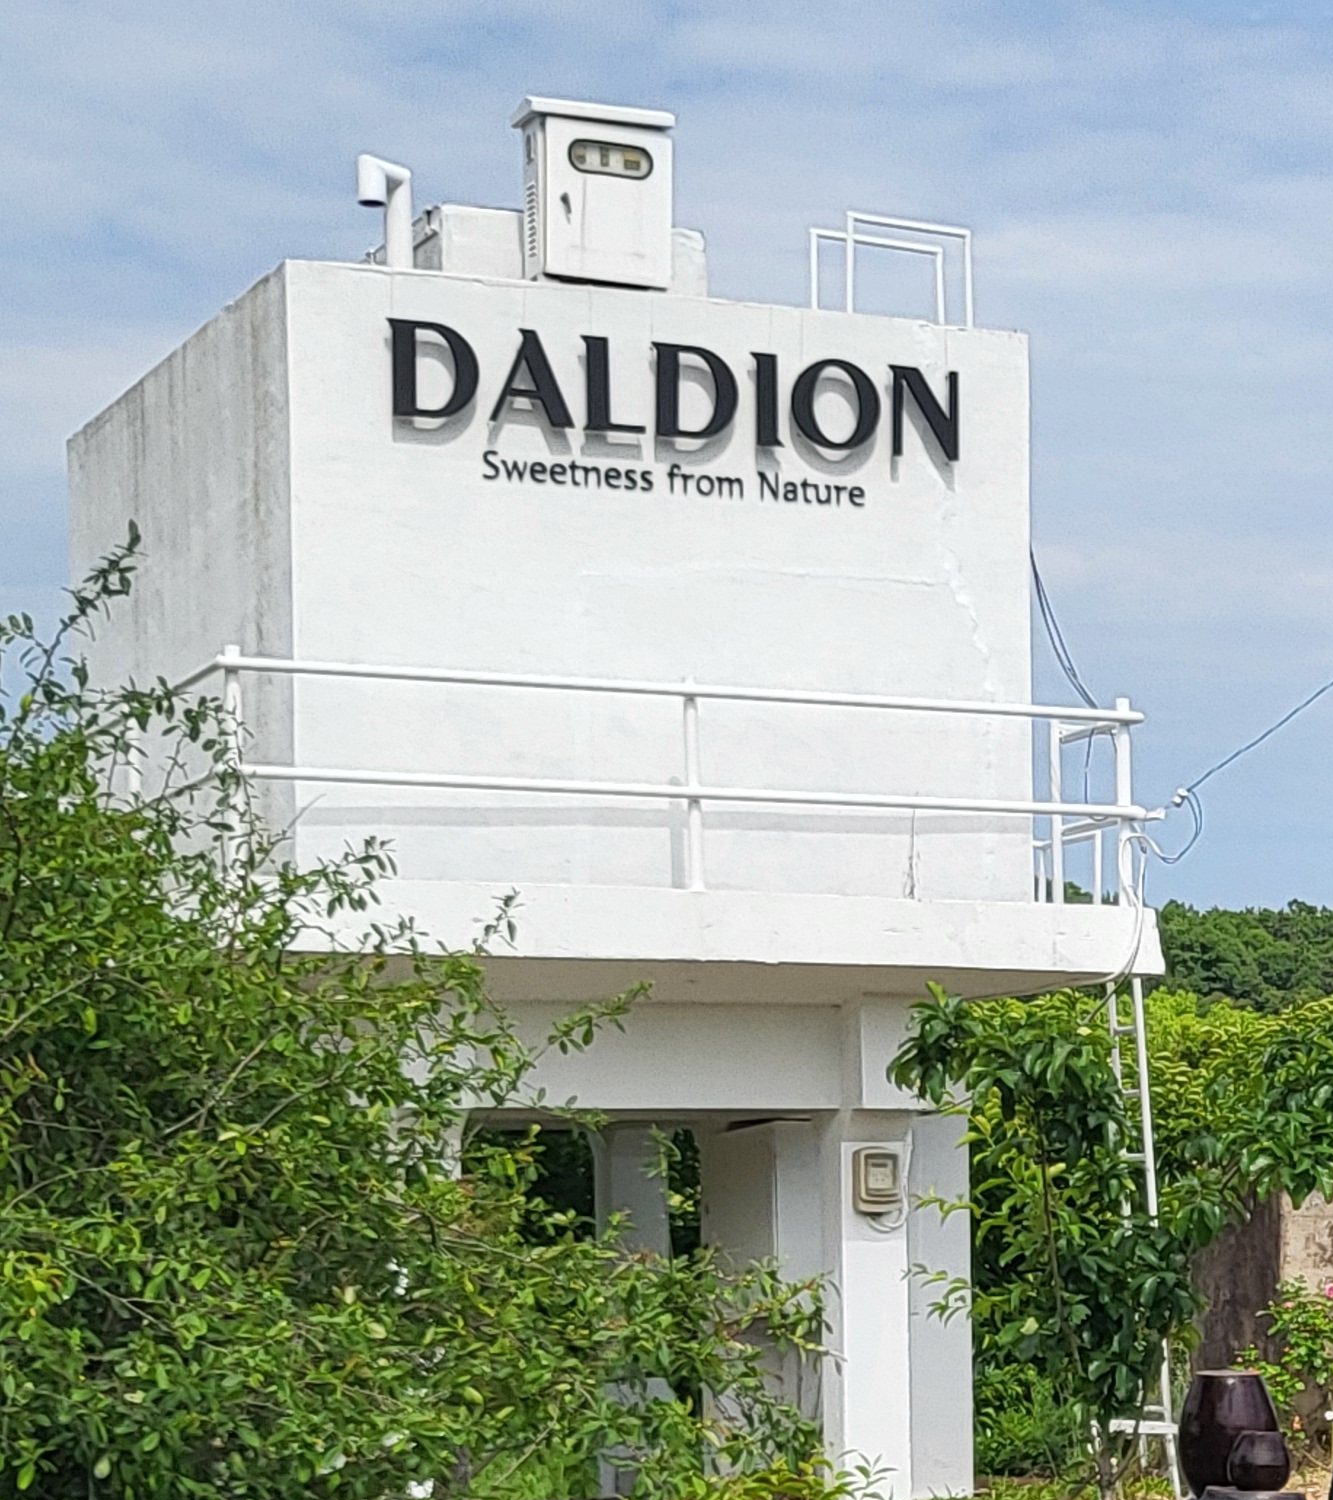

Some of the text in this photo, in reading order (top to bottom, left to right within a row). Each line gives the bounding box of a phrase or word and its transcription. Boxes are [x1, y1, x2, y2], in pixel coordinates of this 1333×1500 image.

[385, 317, 960, 463] DALDION
[482, 450, 866, 507] Sweetness from Nature
